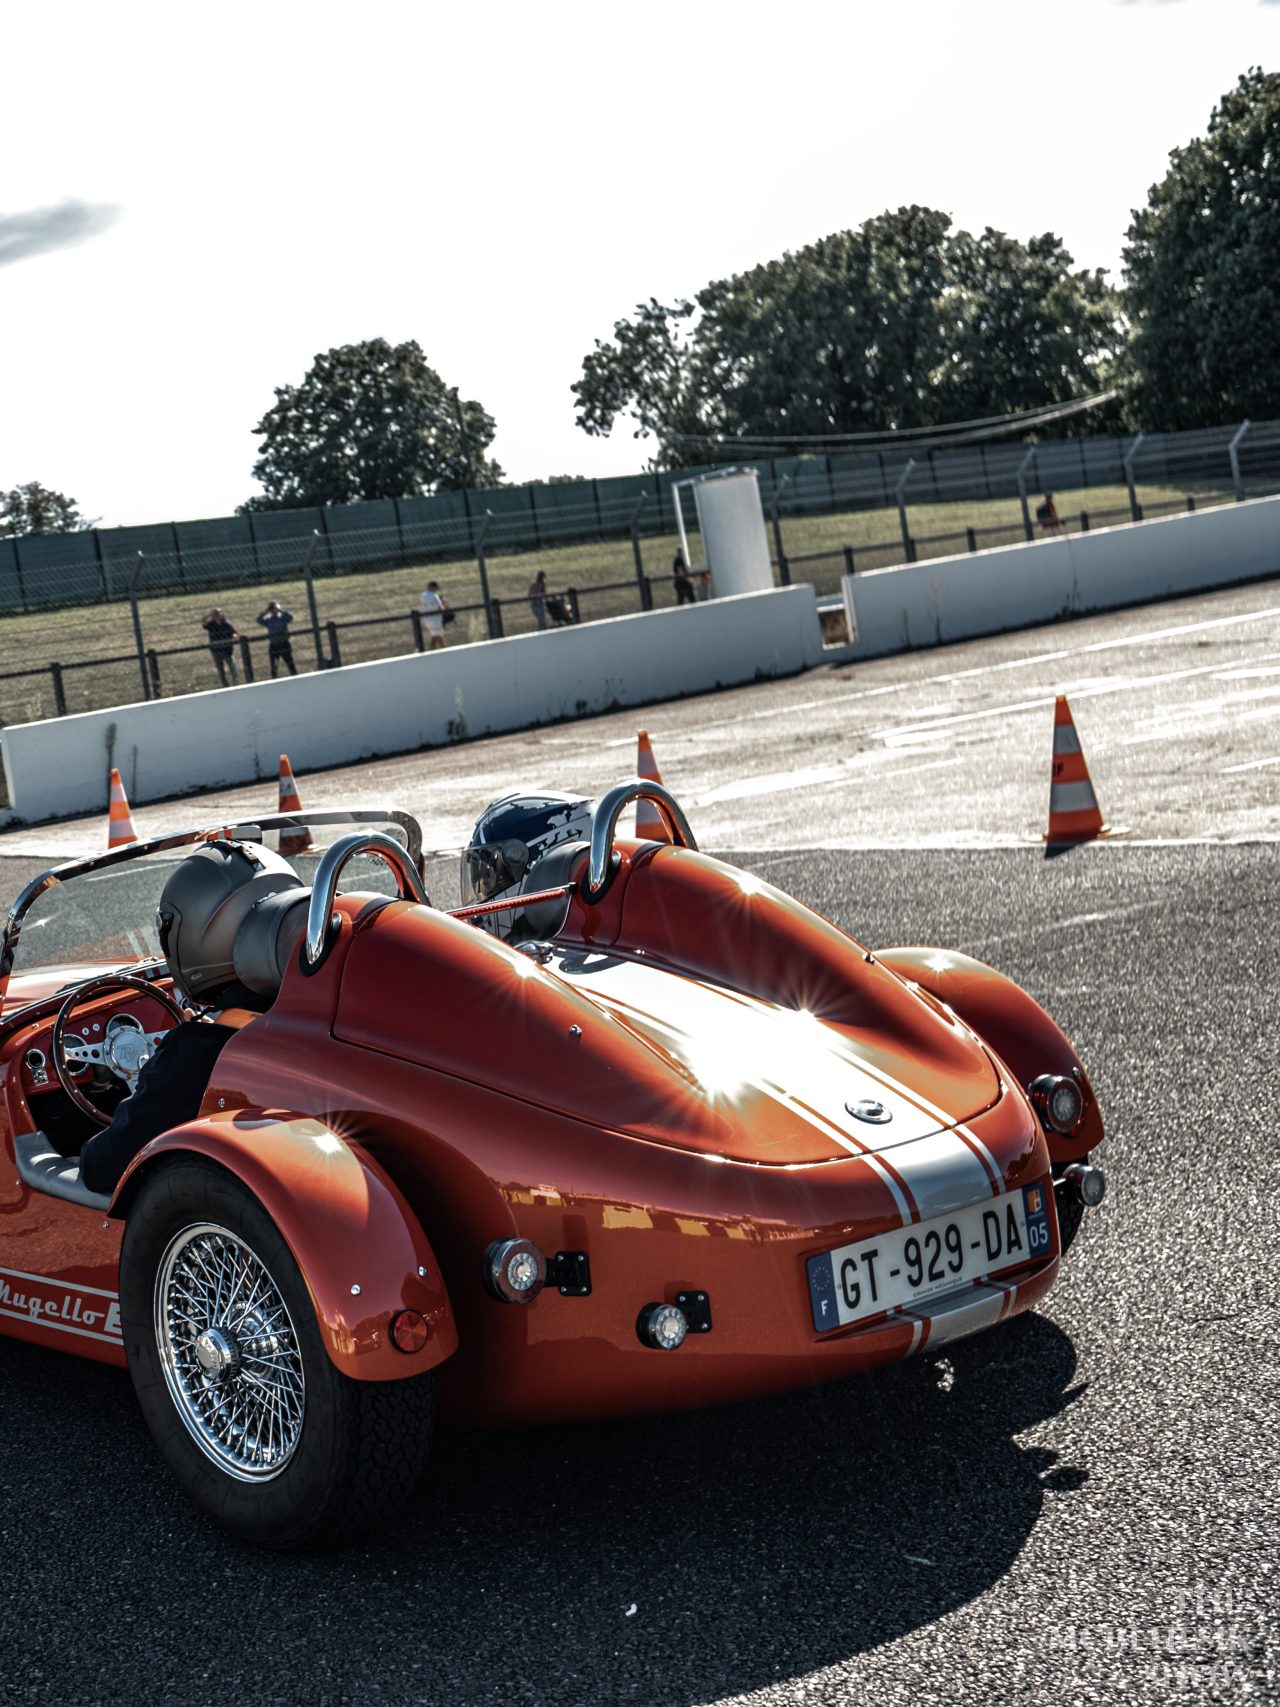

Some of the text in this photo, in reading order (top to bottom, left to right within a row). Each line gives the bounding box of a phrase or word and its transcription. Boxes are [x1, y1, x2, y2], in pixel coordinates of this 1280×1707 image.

[1029, 1222, 1048, 1248] 05
[841, 1203, 1022, 1309] GT-929-DA
[821, 1300, 828, 1316] F
